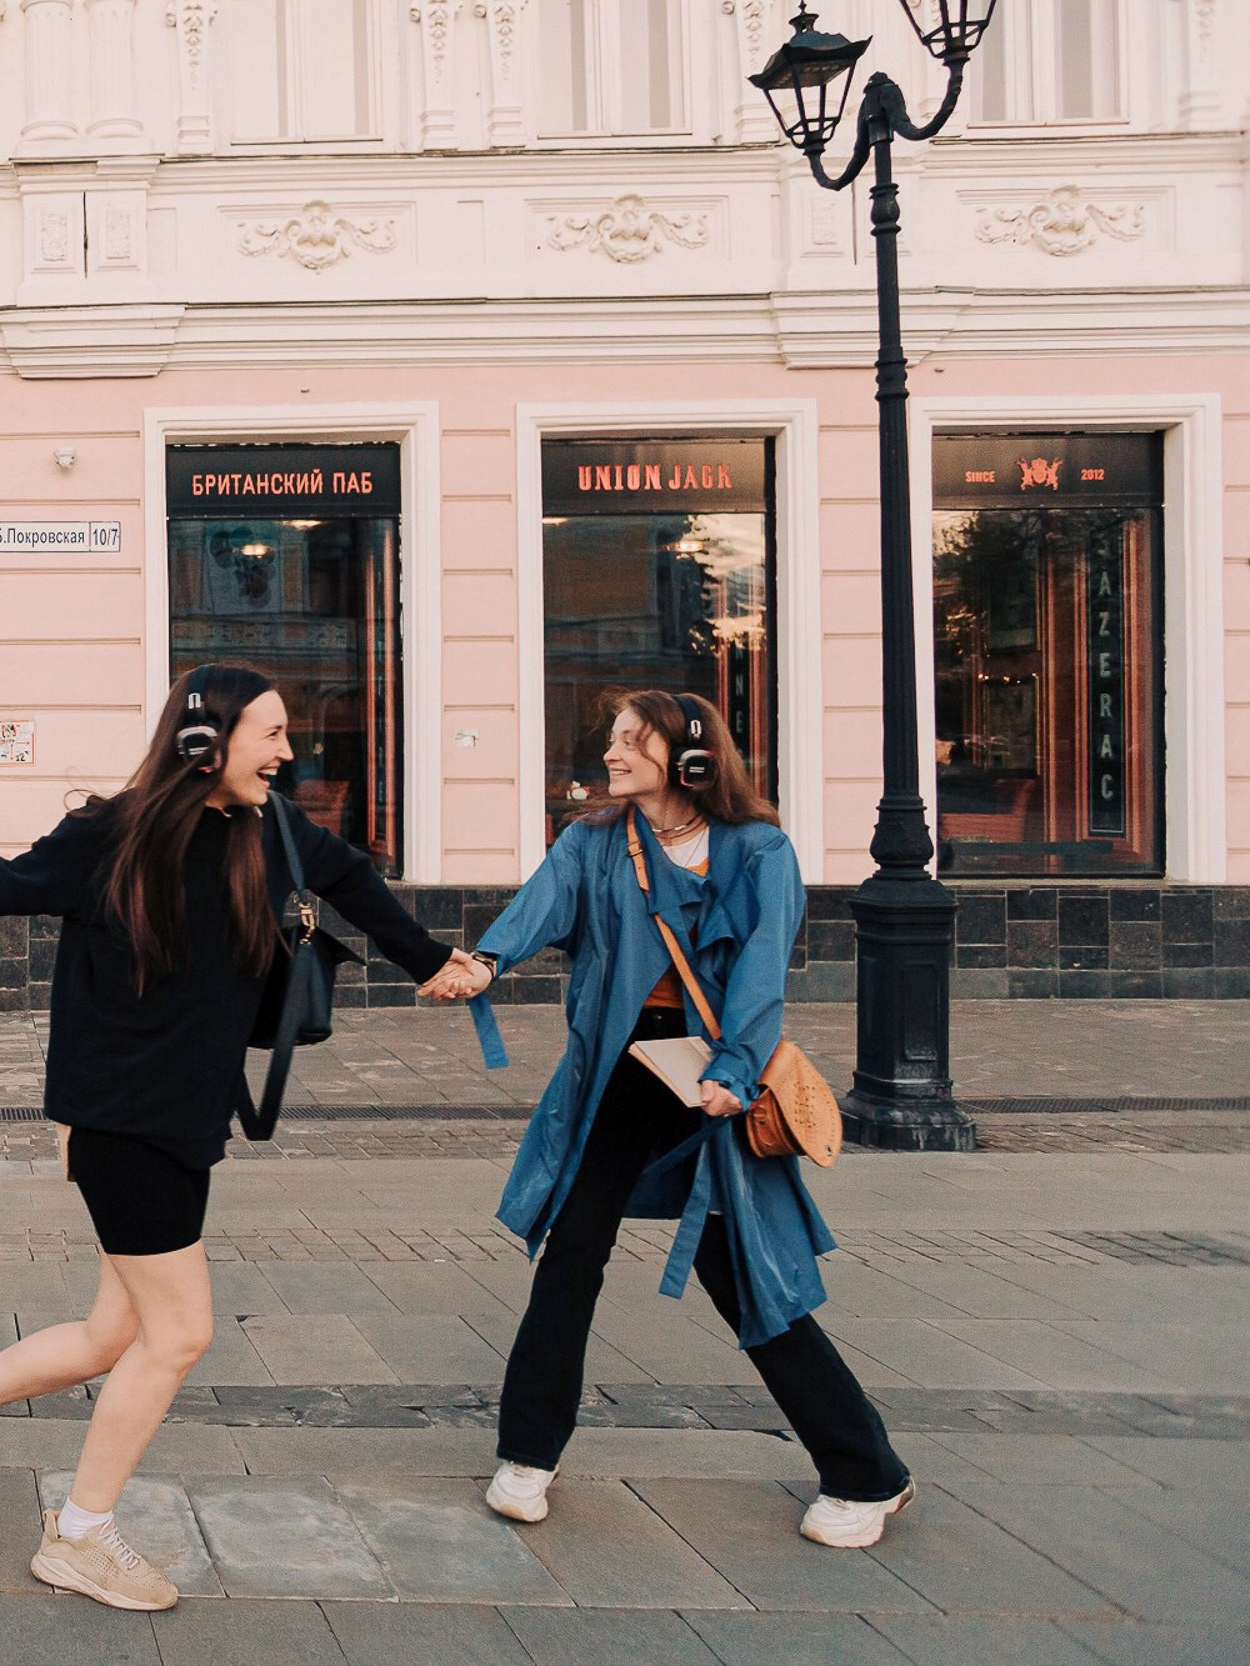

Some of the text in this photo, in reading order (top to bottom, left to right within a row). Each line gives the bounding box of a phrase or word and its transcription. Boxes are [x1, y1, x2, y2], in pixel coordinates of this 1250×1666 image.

[192, 468, 373, 495] БРИТАНСКИЙ ПАБ
[578, 464, 732, 491] UNION JACK
[965, 470, 996, 483] SINCE
[1081, 469, 1104, 481] 2012
[93, 528, 119, 546] 10/7
